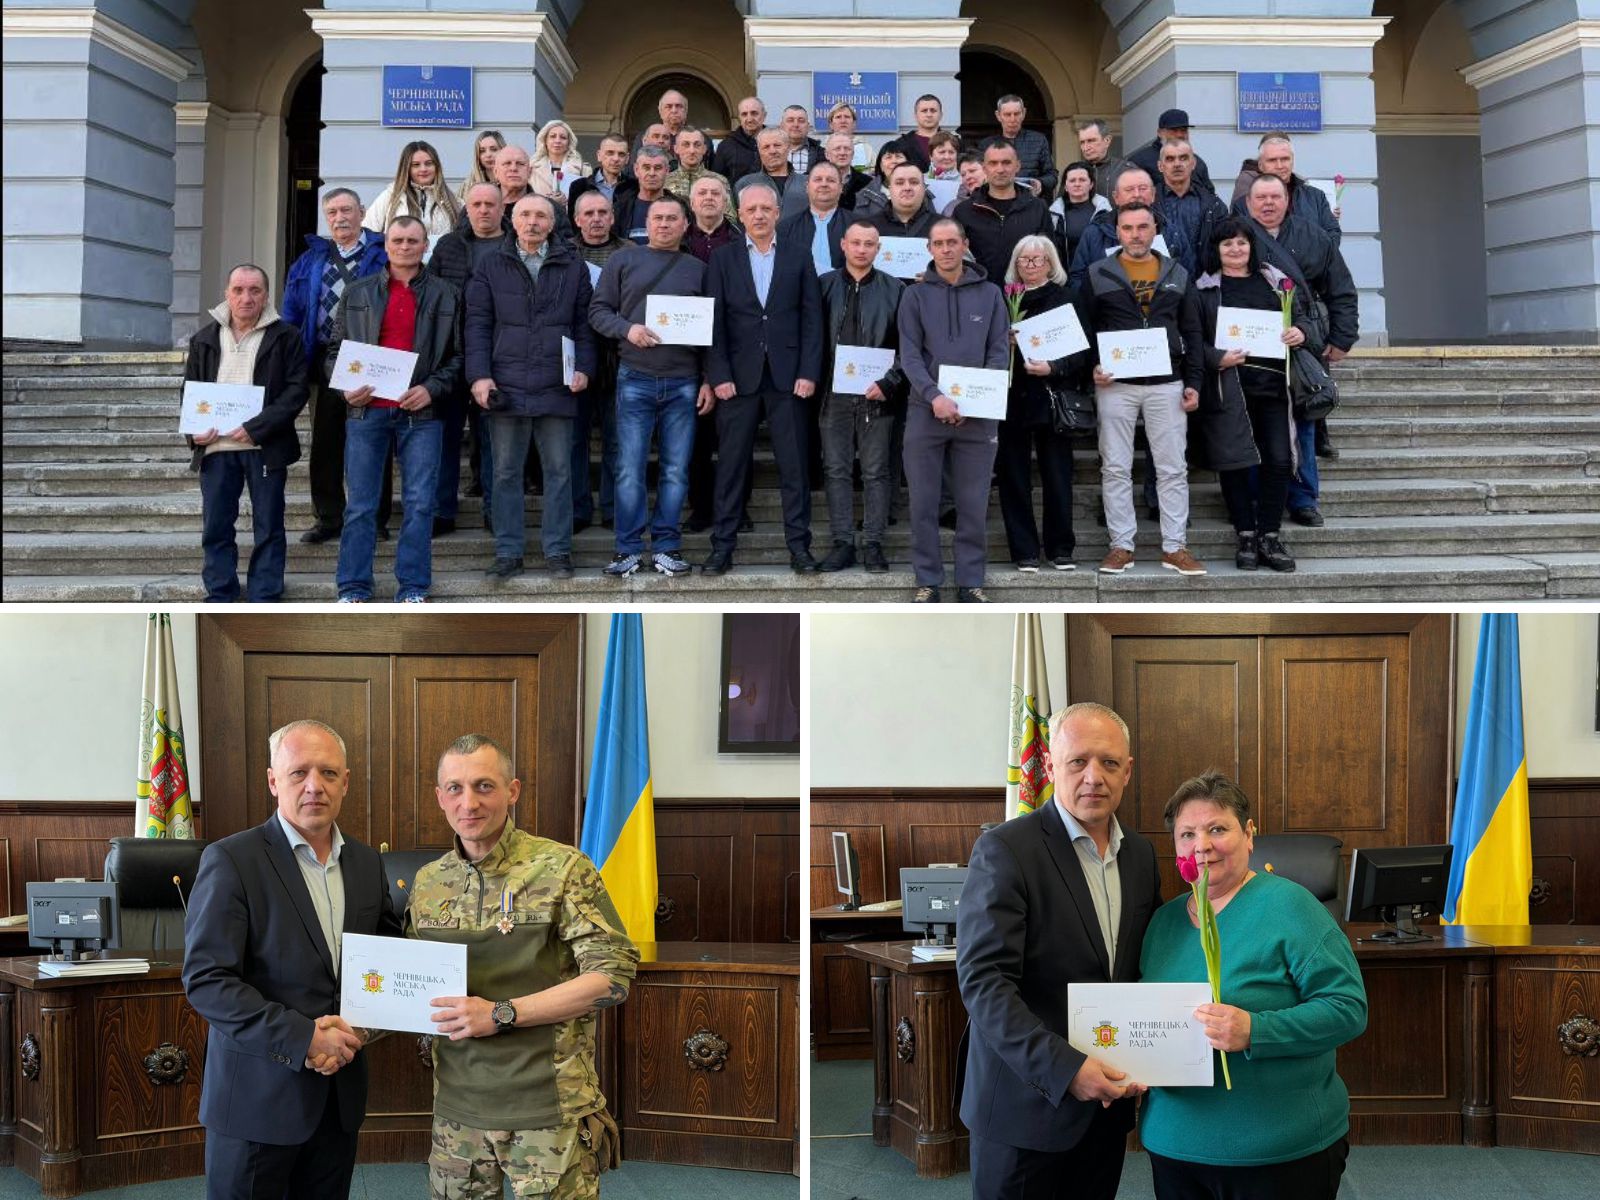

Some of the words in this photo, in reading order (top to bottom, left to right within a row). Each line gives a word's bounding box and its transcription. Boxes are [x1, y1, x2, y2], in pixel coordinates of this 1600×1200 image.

[388, 88, 465, 100] ЧЕРНІВЕЦЬКА
[391, 100, 431, 111] МІСЬКА
[435, 100, 464, 112] РАДА
[393, 972, 446, 985] ЧЕРНІВЕЦЬКА
[393, 980, 427, 991] МІСЬКА
[393, 989, 415, 998] РАДА
[1128, 1021, 1189, 1030] ЧЕРНІВЕЦЬКА
[1128, 1031, 1168, 1039] МІСЬКА
[1128, 1039, 1154, 1048] РАДА
